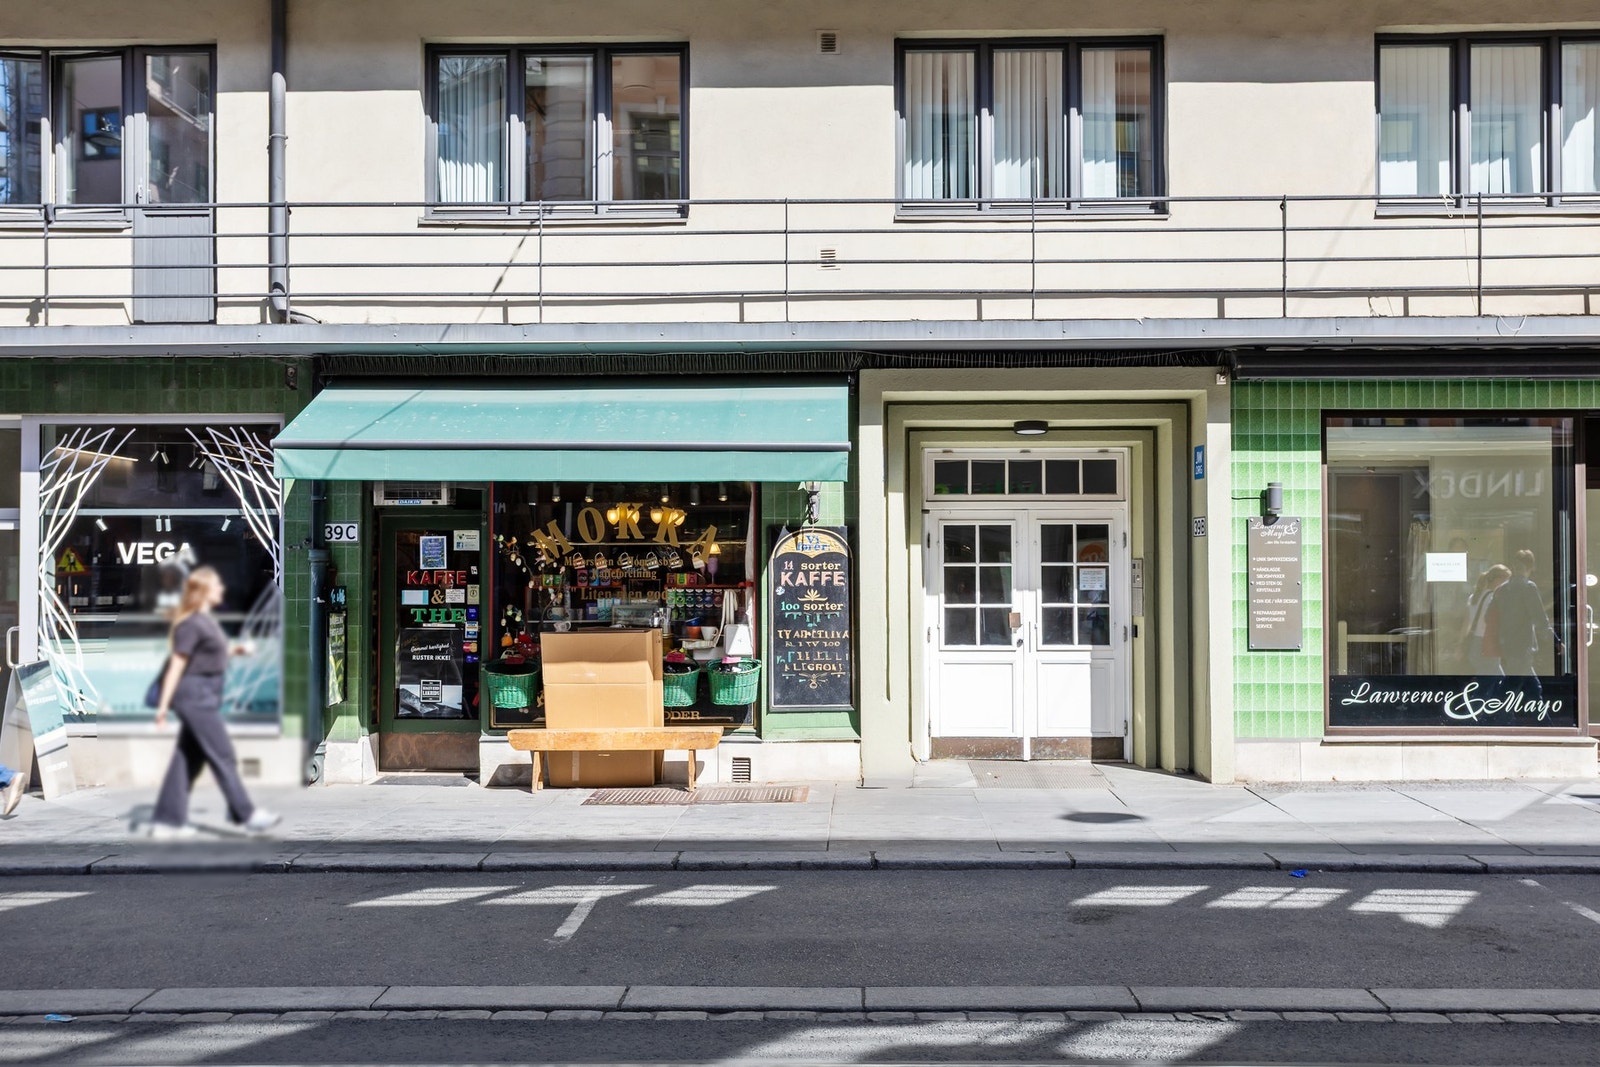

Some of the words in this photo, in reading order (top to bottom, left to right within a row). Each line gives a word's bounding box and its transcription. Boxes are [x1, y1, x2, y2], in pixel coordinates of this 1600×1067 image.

[531, 502, 718, 565] MOKKA
[806, 535, 820, 544] Vi
[784, 560, 794, 570] 14
[801, 561, 841, 570] sorter
[406, 570, 467, 585] KAFFE
[780, 571, 845, 587] KAFFE
[431, 588, 444, 605] &
[803, 602, 844, 611] sorter
[410, 608, 465, 623] THE
[1341, 681, 1454, 706] Lawrence
[1444, 681, 1485, 722] &
[1483, 690, 1563, 722] Mayo
